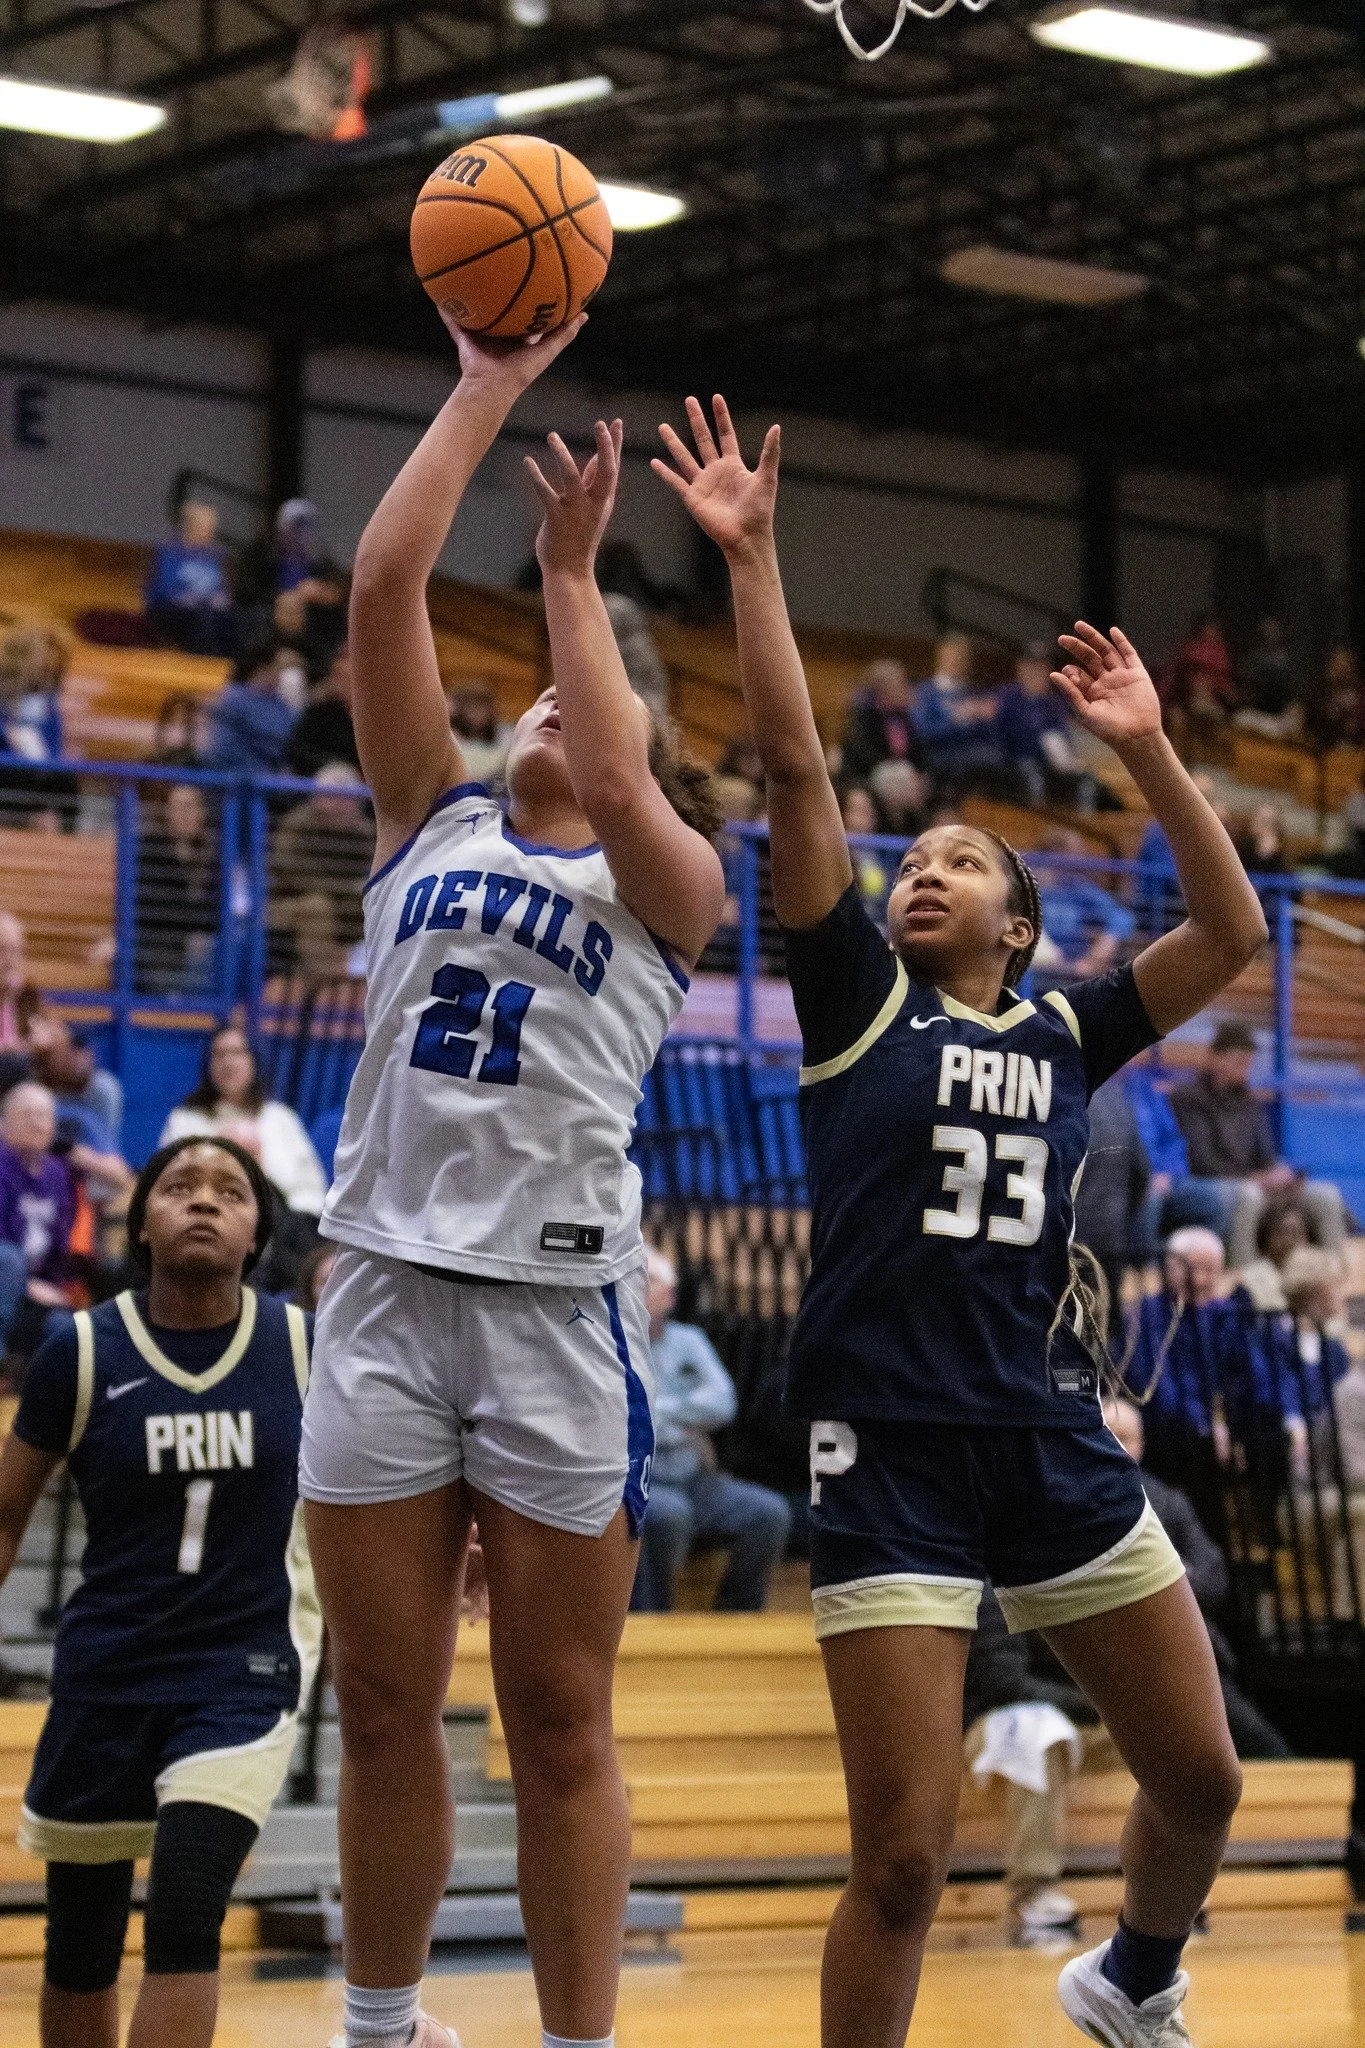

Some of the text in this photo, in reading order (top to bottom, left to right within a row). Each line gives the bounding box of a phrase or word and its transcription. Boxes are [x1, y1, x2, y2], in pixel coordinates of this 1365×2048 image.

[394, 870, 613, 997] DEVILS
[409, 962, 536, 1086] 21
[937, 1044, 1051, 1123] PRIN
[922, 1125, 1049, 1246] 33
[585, 1234, 592, 1245] L
[1081, 1376, 1090, 1387] M
[145, 1410, 254, 1474] PRIN
[809, 1420, 858, 1505] P
[177, 1478, 213, 1574] 1
